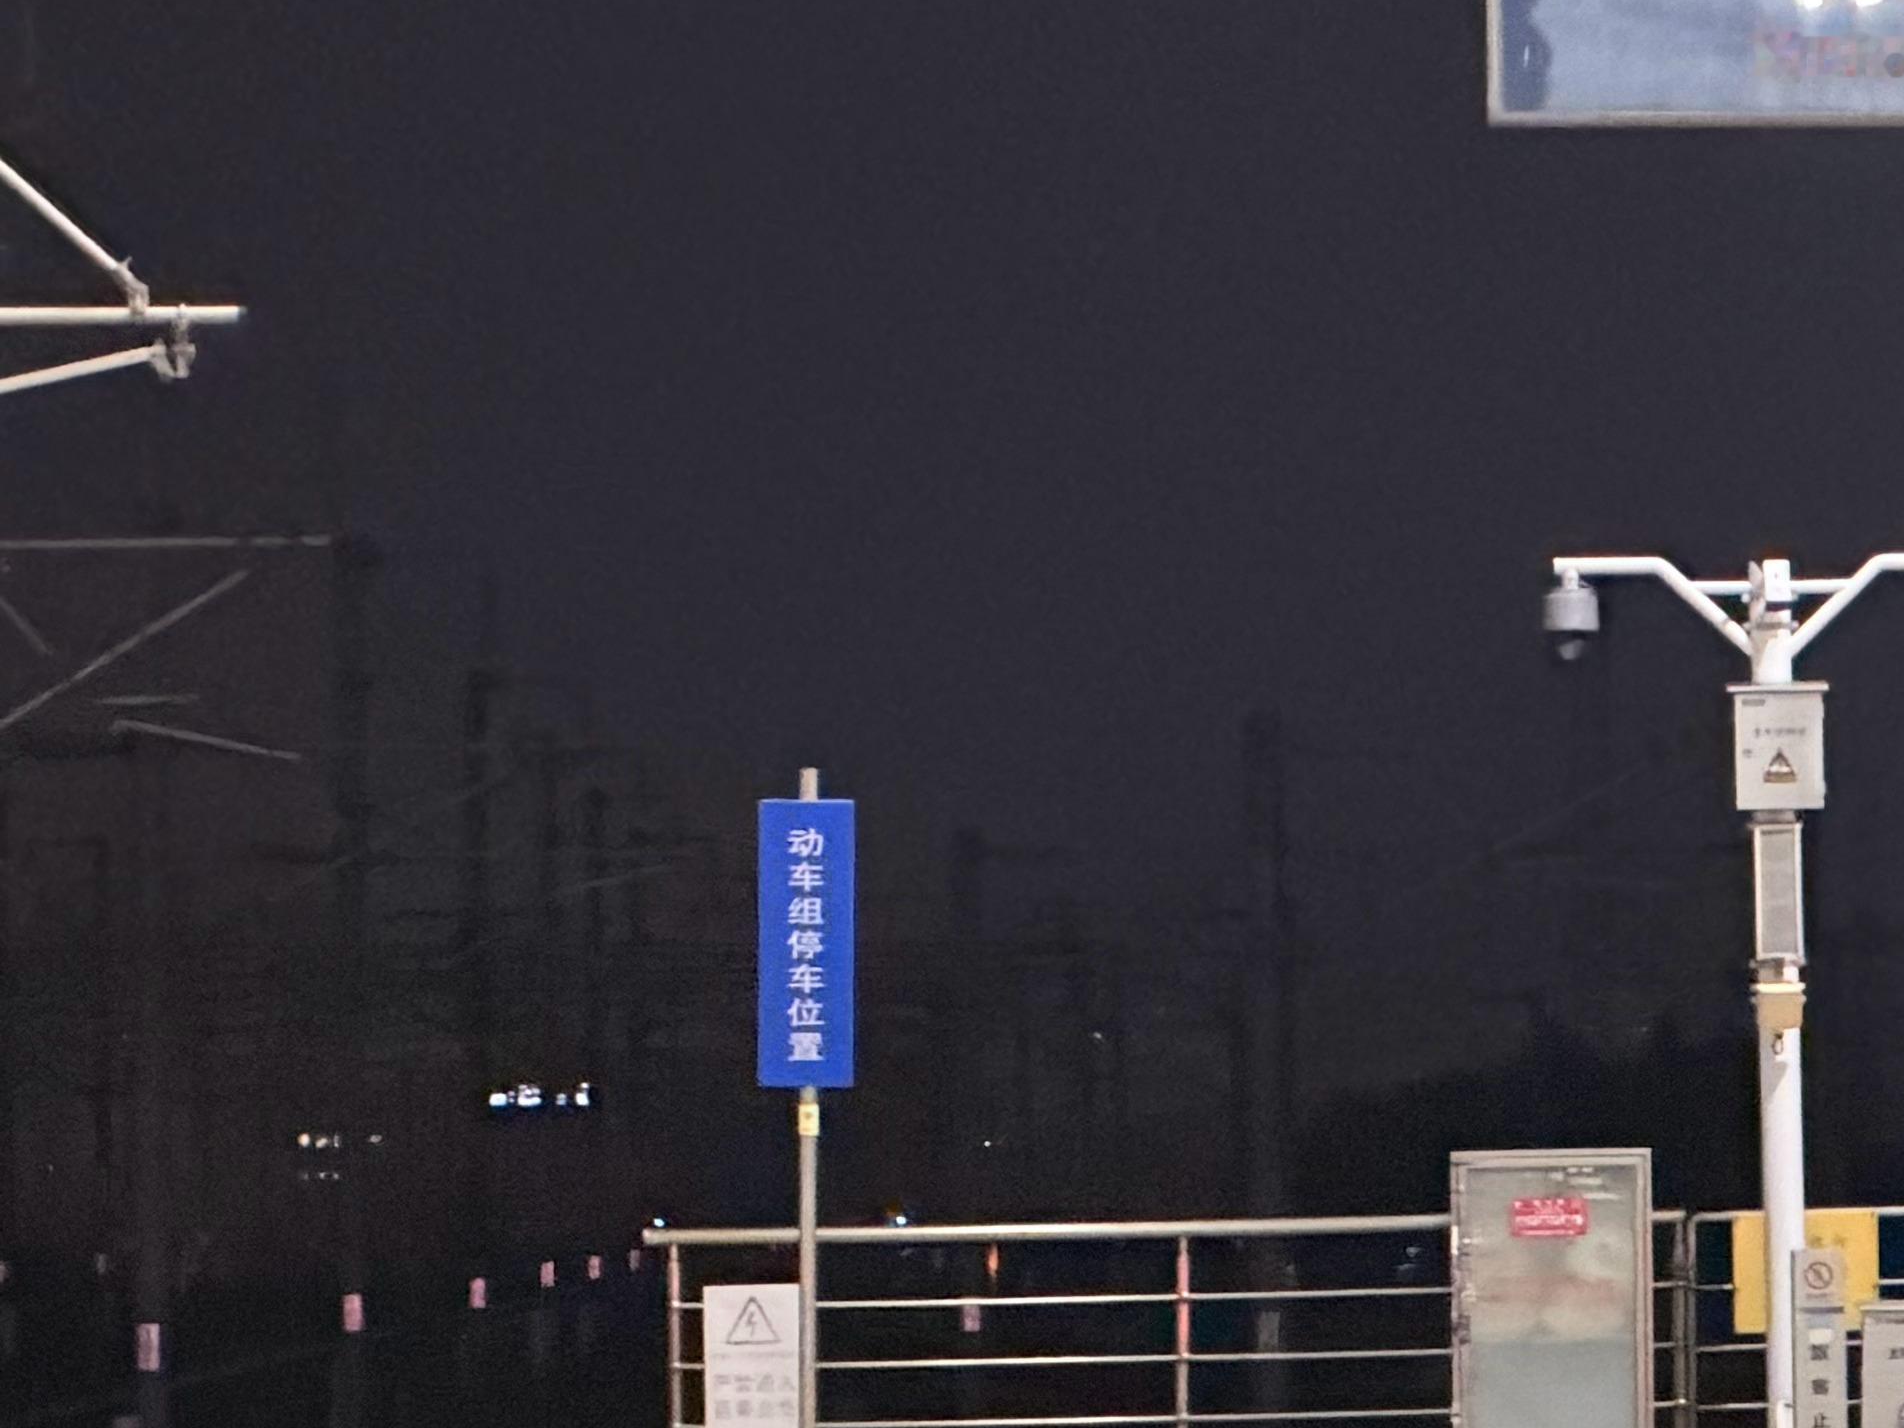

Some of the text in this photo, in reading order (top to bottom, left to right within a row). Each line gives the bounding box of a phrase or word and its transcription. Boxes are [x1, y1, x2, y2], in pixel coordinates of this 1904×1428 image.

[786, 828, 825, 1062] 动车组停车位置
